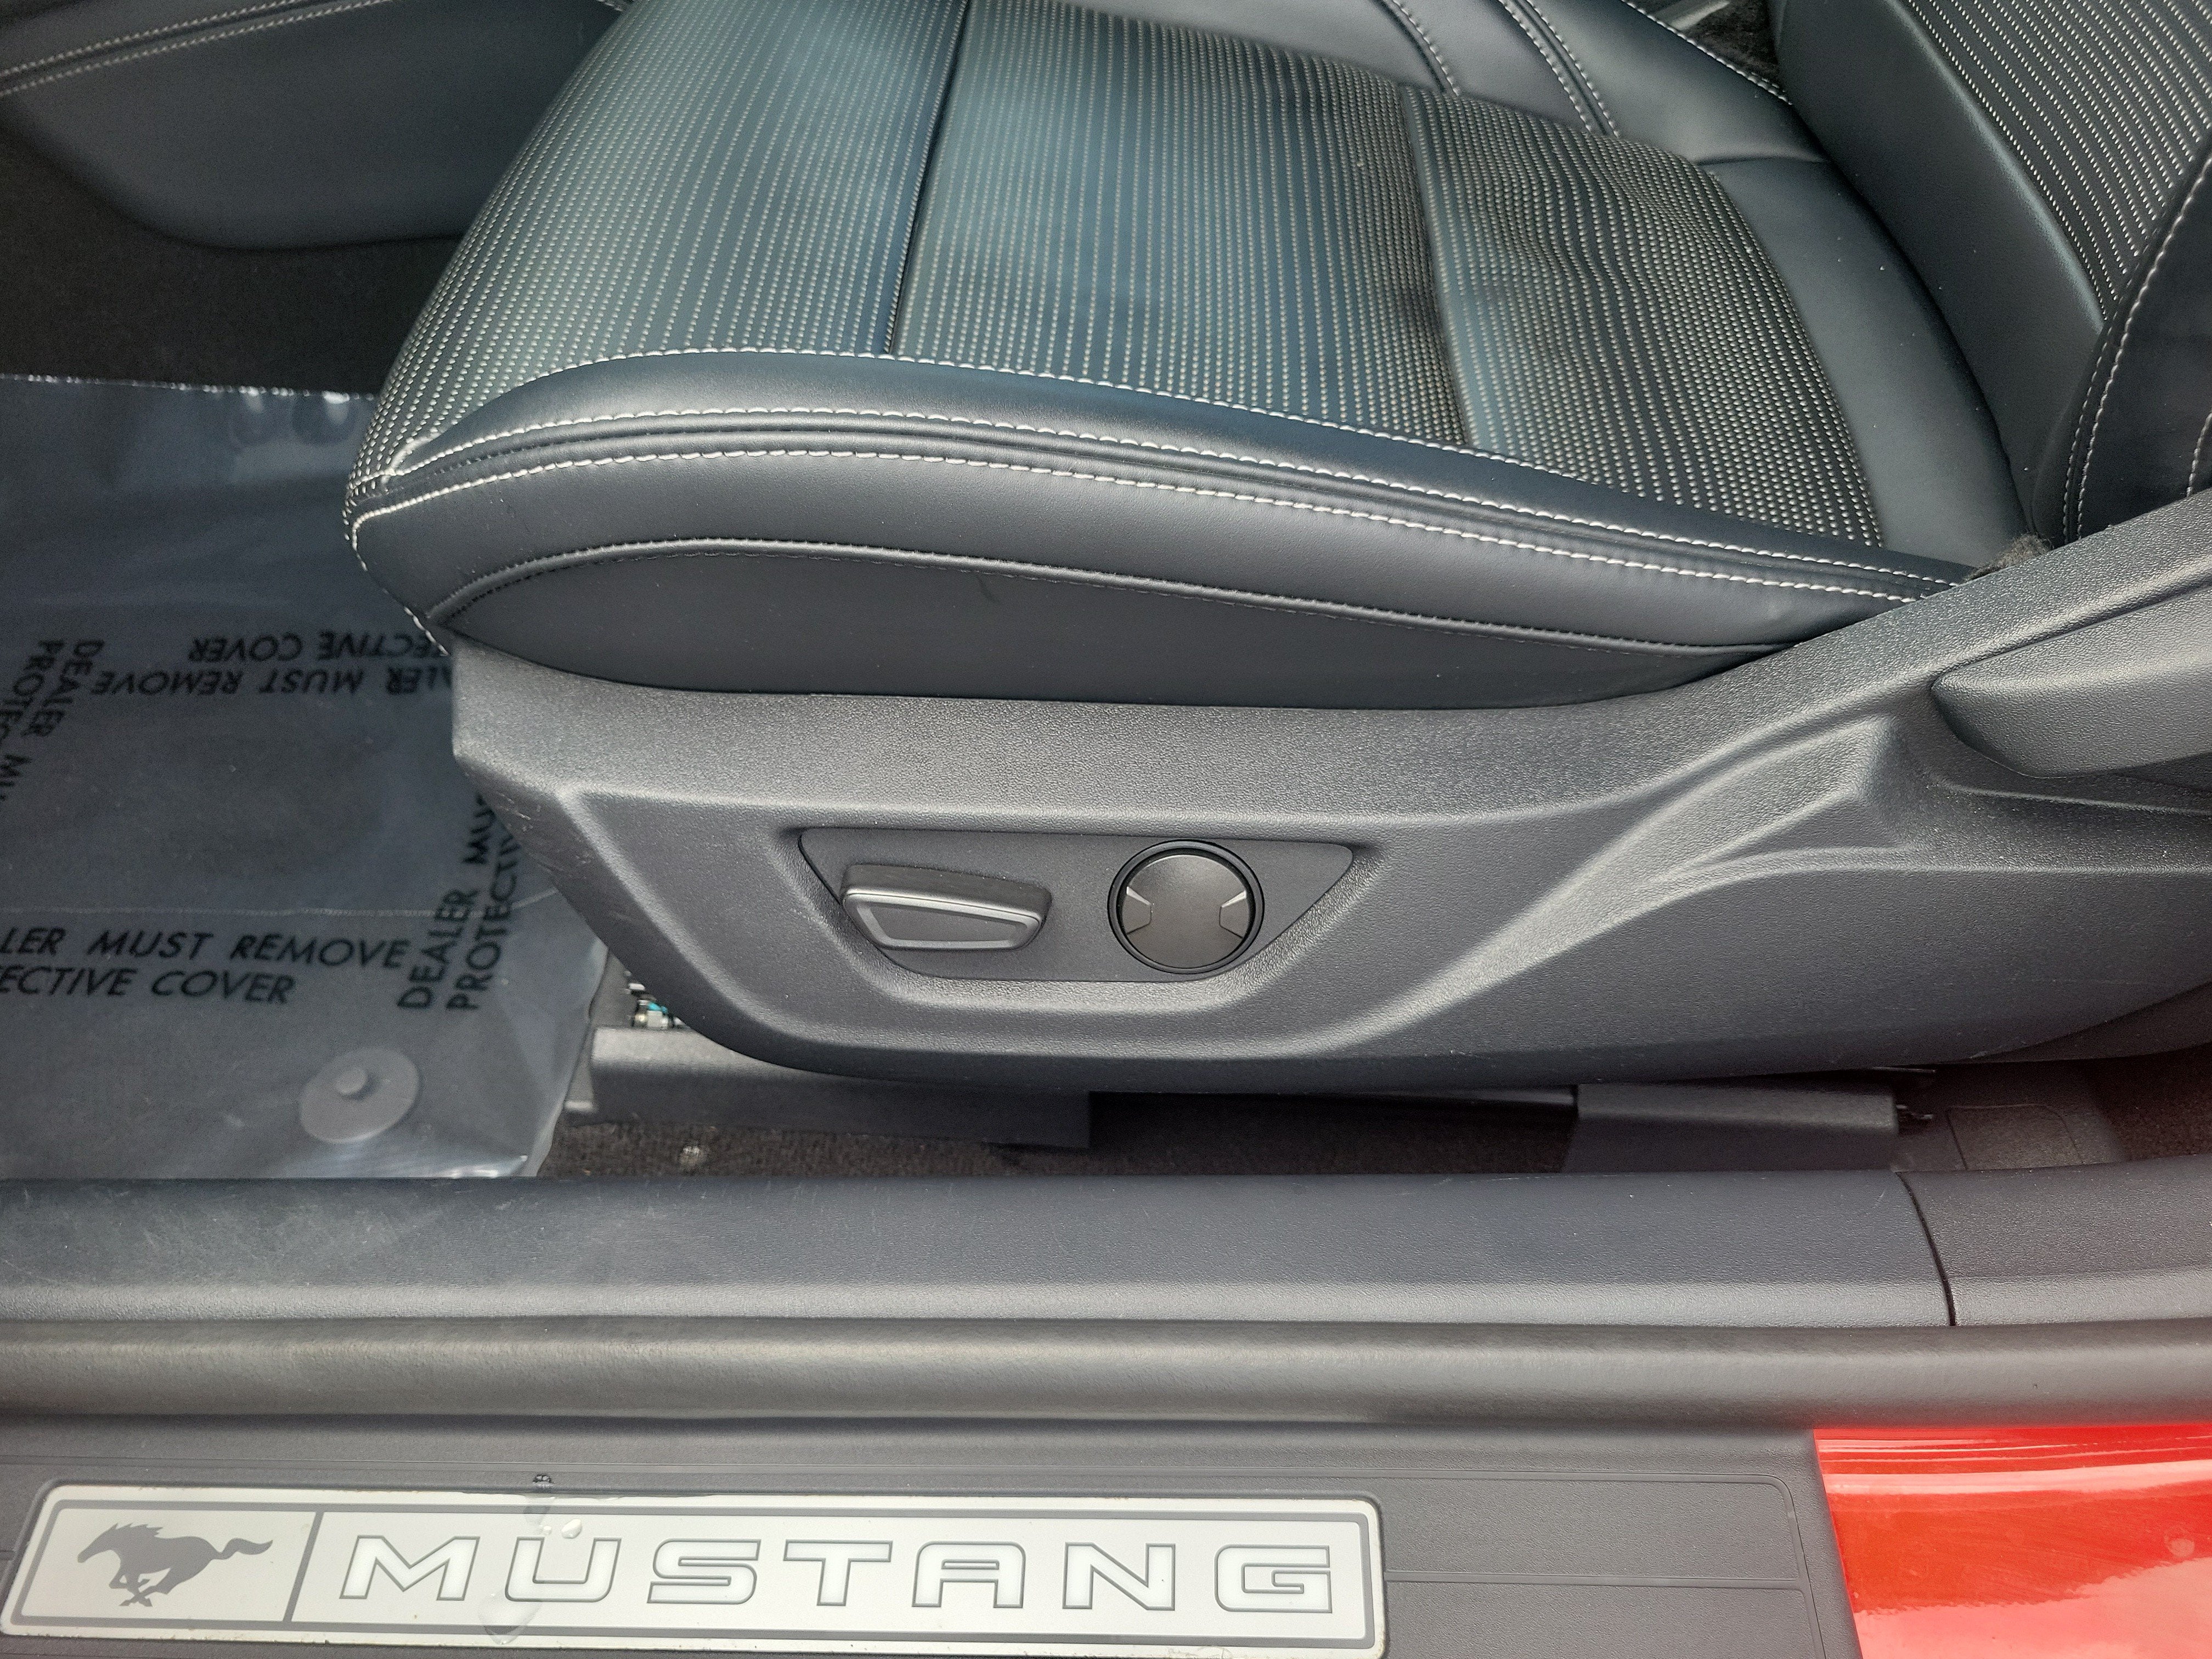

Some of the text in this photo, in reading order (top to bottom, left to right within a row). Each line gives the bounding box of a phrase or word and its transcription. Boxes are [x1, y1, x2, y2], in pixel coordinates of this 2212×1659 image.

[188, 629, 441, 662] ECTIVE COVER
[21, 640, 105, 737] DEALER
[90, 670, 244, 696] REMOVE
[258, 668, 364, 695] MUST
[396, 793, 495, 1008] DEALER MU
[0, 927, 410, 968] LER MUST REMOVE
[0, 964, 296, 1004] ECTIVE COVER
[340, 1535, 1332, 1613] MUSTANG
